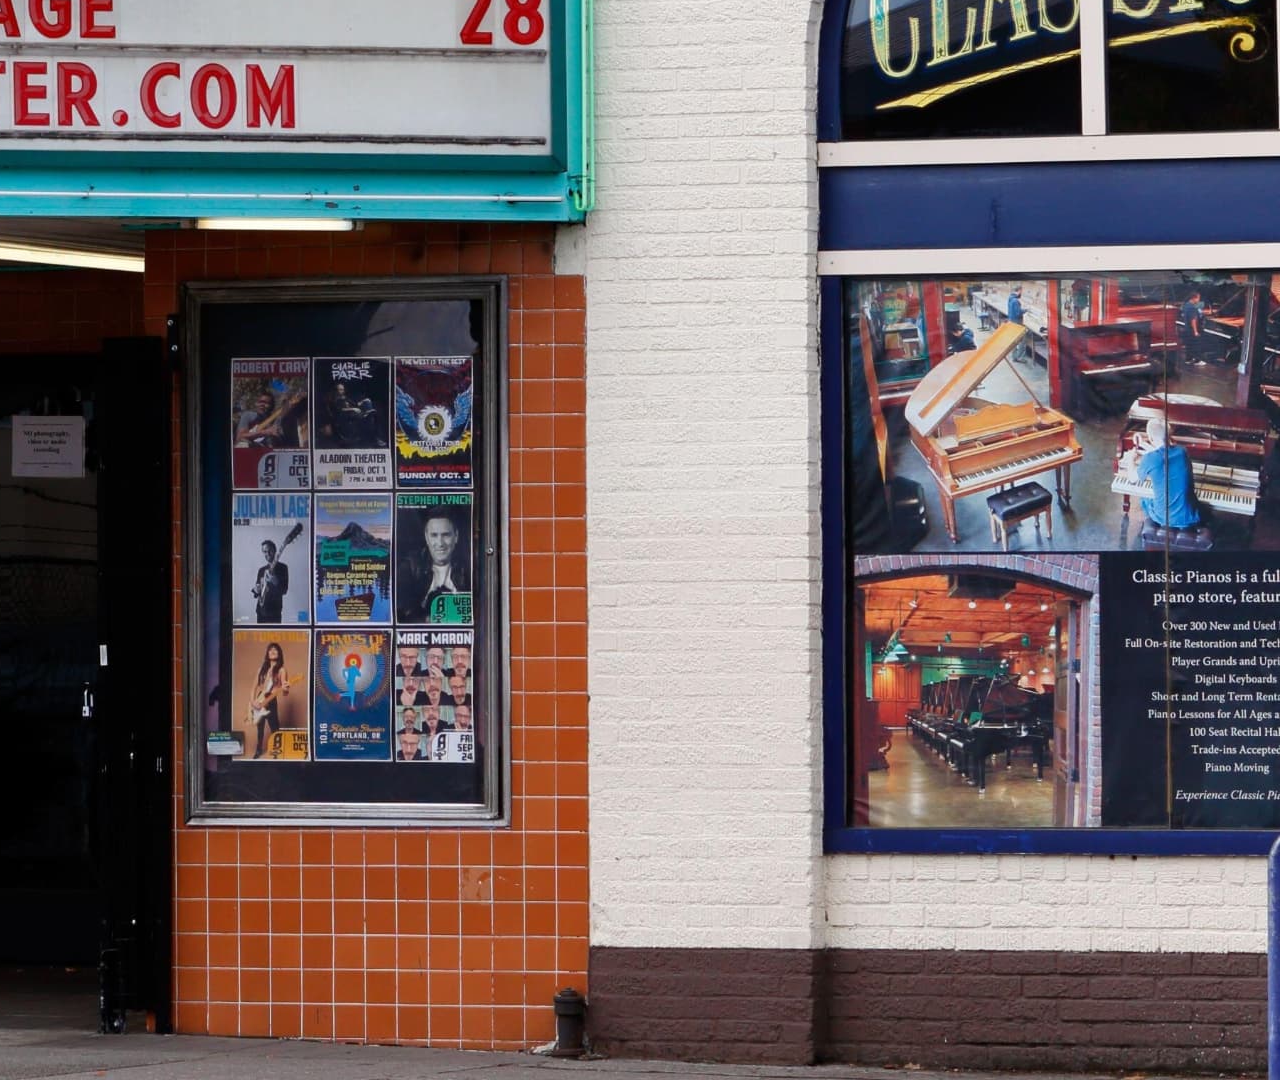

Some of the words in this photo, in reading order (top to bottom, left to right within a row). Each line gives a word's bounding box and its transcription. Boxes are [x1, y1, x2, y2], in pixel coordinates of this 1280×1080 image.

[233, 362, 276, 373] ROBERT
[279, 361, 308, 373] CRAY
[331, 361, 371, 371] CHARLIE
[331, 370, 374, 380] PARR
[292, 455, 308, 465] FRI
[319, 454, 352, 464] ALADDIN
[354, 454, 386, 464] THEATER
[289, 466, 308, 476] OCT
[367, 466, 378, 474] OCT
[297, 477, 308, 487] 15
[397, 495, 440, 505] STEPHEN
[441, 495, 471, 505] LYNCH
[234, 496, 276, 518] JULIAN
[282, 495, 309, 518] LAGE
[1132, 570, 1183, 584] Classic
[1186, 570, 1232, 583] Pianos
[1235, 570, 1247, 583] is
[1250, 573, 1258, 583] a
[453, 597, 471, 606] WED
[1153, 590, 1194, 606] piano
[1198, 592, 1237, 605] store,
[456, 606, 471, 615] SEP
[1162, 621, 1188, 631] Over
[1190, 621, 1208, 631] 300
[1209, 621, 1231, 631] New
[1232, 620, 1250, 631] and
[1253, 621, 1276, 631] Used
[397, 633, 429, 645] MARC
[431, 633, 472, 645] MARON
[1125, 638, 1142, 648] Full
[1144, 638, 1182, 648] On-site
[1184, 638, 1237, 648] Restoration
[1240, 638, 1257, 648] and
[1171, 656, 1200, 669] Player
[1202, 656, 1237, 666] Grands
[1239, 656, 1256, 666] and
[1194, 673, 1226, 686] Digital
[1228, 673, 1277, 686] Keyboards
[1151, 691, 1179, 701] Short
[1181, 691, 1199, 701] and
[1201, 691, 1225, 703] Long
[1227, 691, 1253, 701] Term
[1147, 709, 1176, 719] Piano
[1179, 709, 1215, 719] Lessons
[1217, 709, 1231, 719] for
[1233, 709, 1247, 719] All
[1249, 709, 1272, 721] Ages
[333, 732, 369, 740] PORTLAND,
[1189, 727, 1206, 737] 100
[1208, 727, 1227, 737] Seat
[1230, 727, 1262, 737] Recital
[460, 734, 473, 743] FRI
[457, 744, 473, 752] SEP
[1191, 744, 1237, 755] Trade-ins
[462, 752, 473, 761] 24
[1205, 762, 1232, 773] Piano
[1233, 762, 1270, 775] Moving
[1175, 789, 1228, 803] Experience
[1230, 789, 1265, 800] Classic
